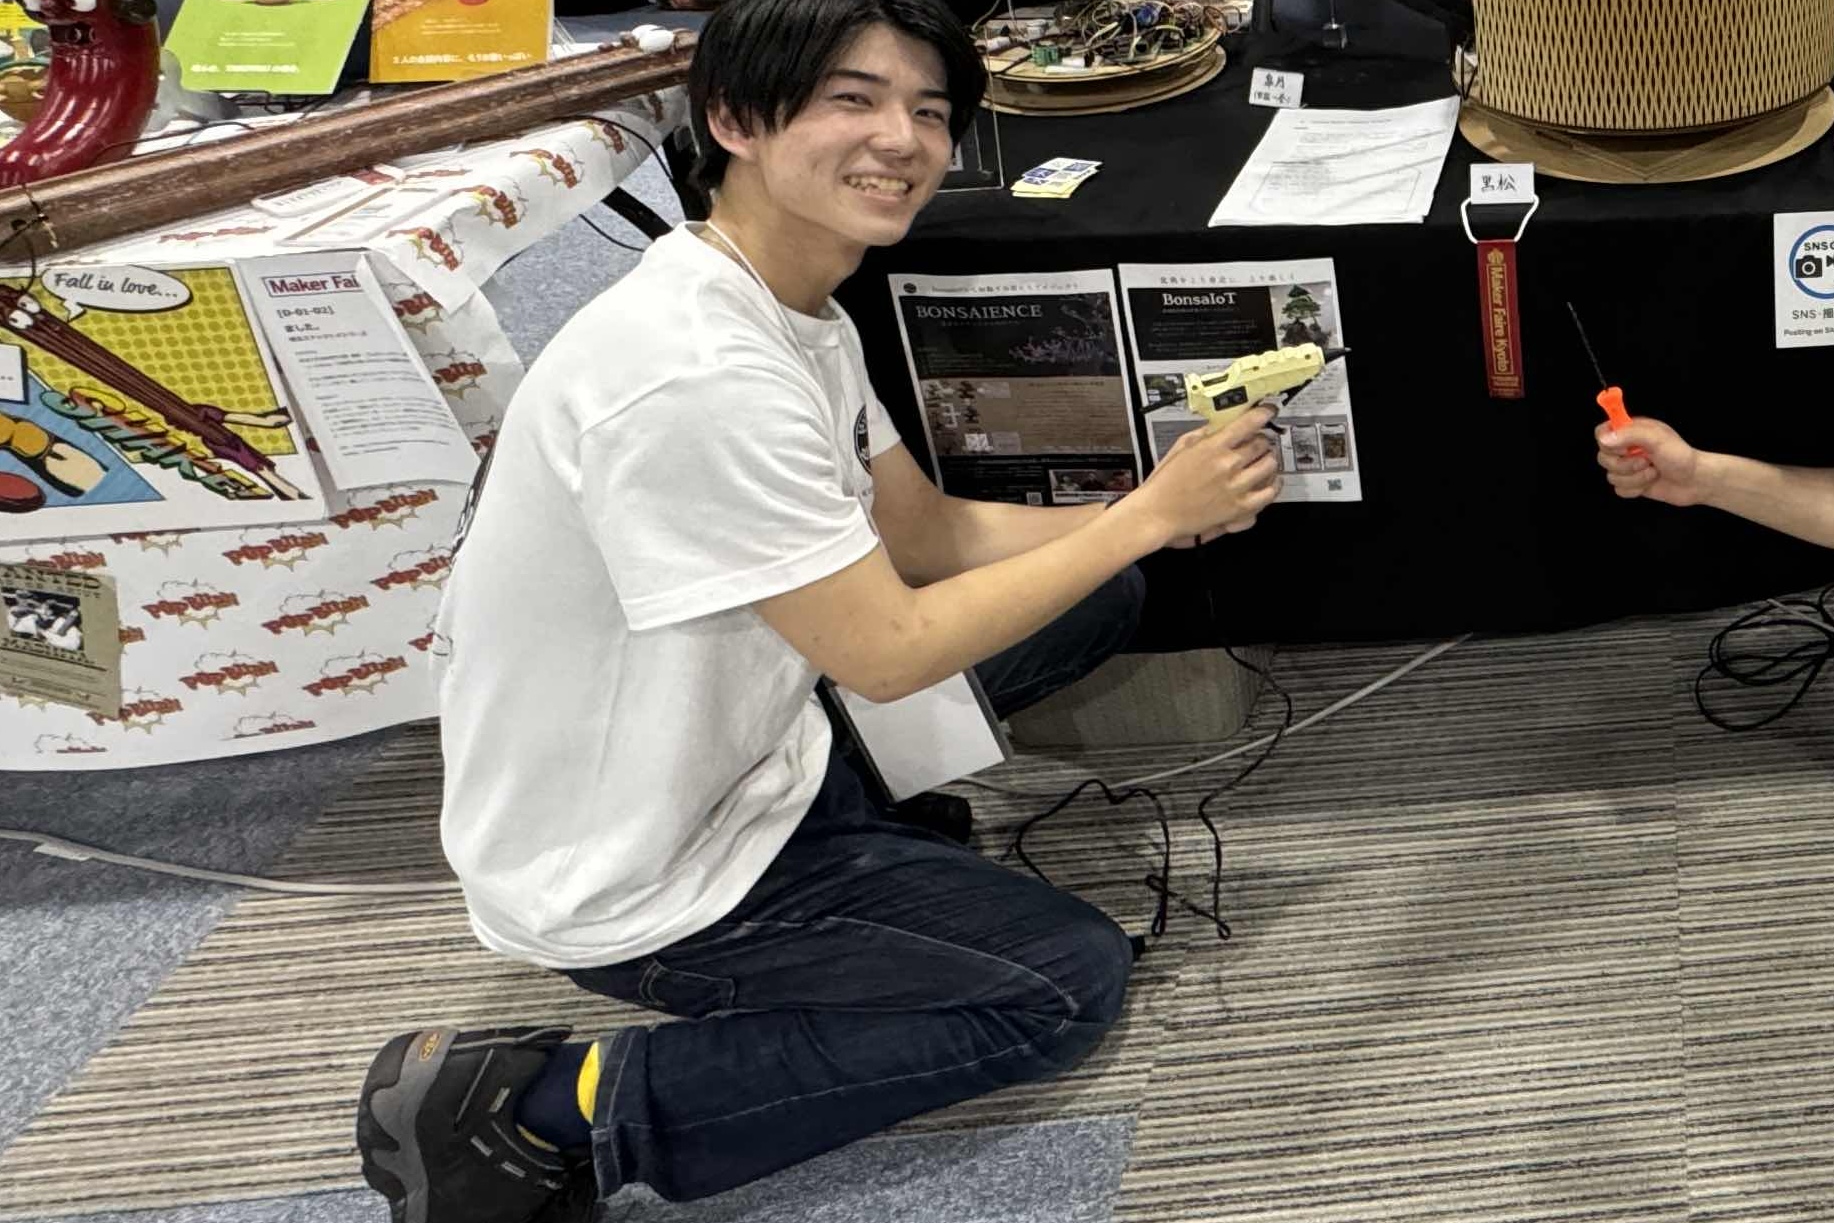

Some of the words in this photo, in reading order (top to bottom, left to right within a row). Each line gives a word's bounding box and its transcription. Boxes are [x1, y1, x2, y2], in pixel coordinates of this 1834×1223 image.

[1481, 174, 1518, 193] 黒松
[1803, 241, 1829, 252] SNS
[53, 272, 93, 291] Fall
[97, 277, 115, 293] in
[269, 277, 329, 295] Maker
[332, 274, 360, 290] Fai
[1490, 267, 1505, 306] Maker
[1162, 292, 1237, 306] BonsaIoT
[916, 304, 1043, 319] BONSAIENCE
[1493, 308, 1507, 337] Faire
[1783, 328, 1812, 337] Posting
[1494, 339, 1509, 372] Kyoto
